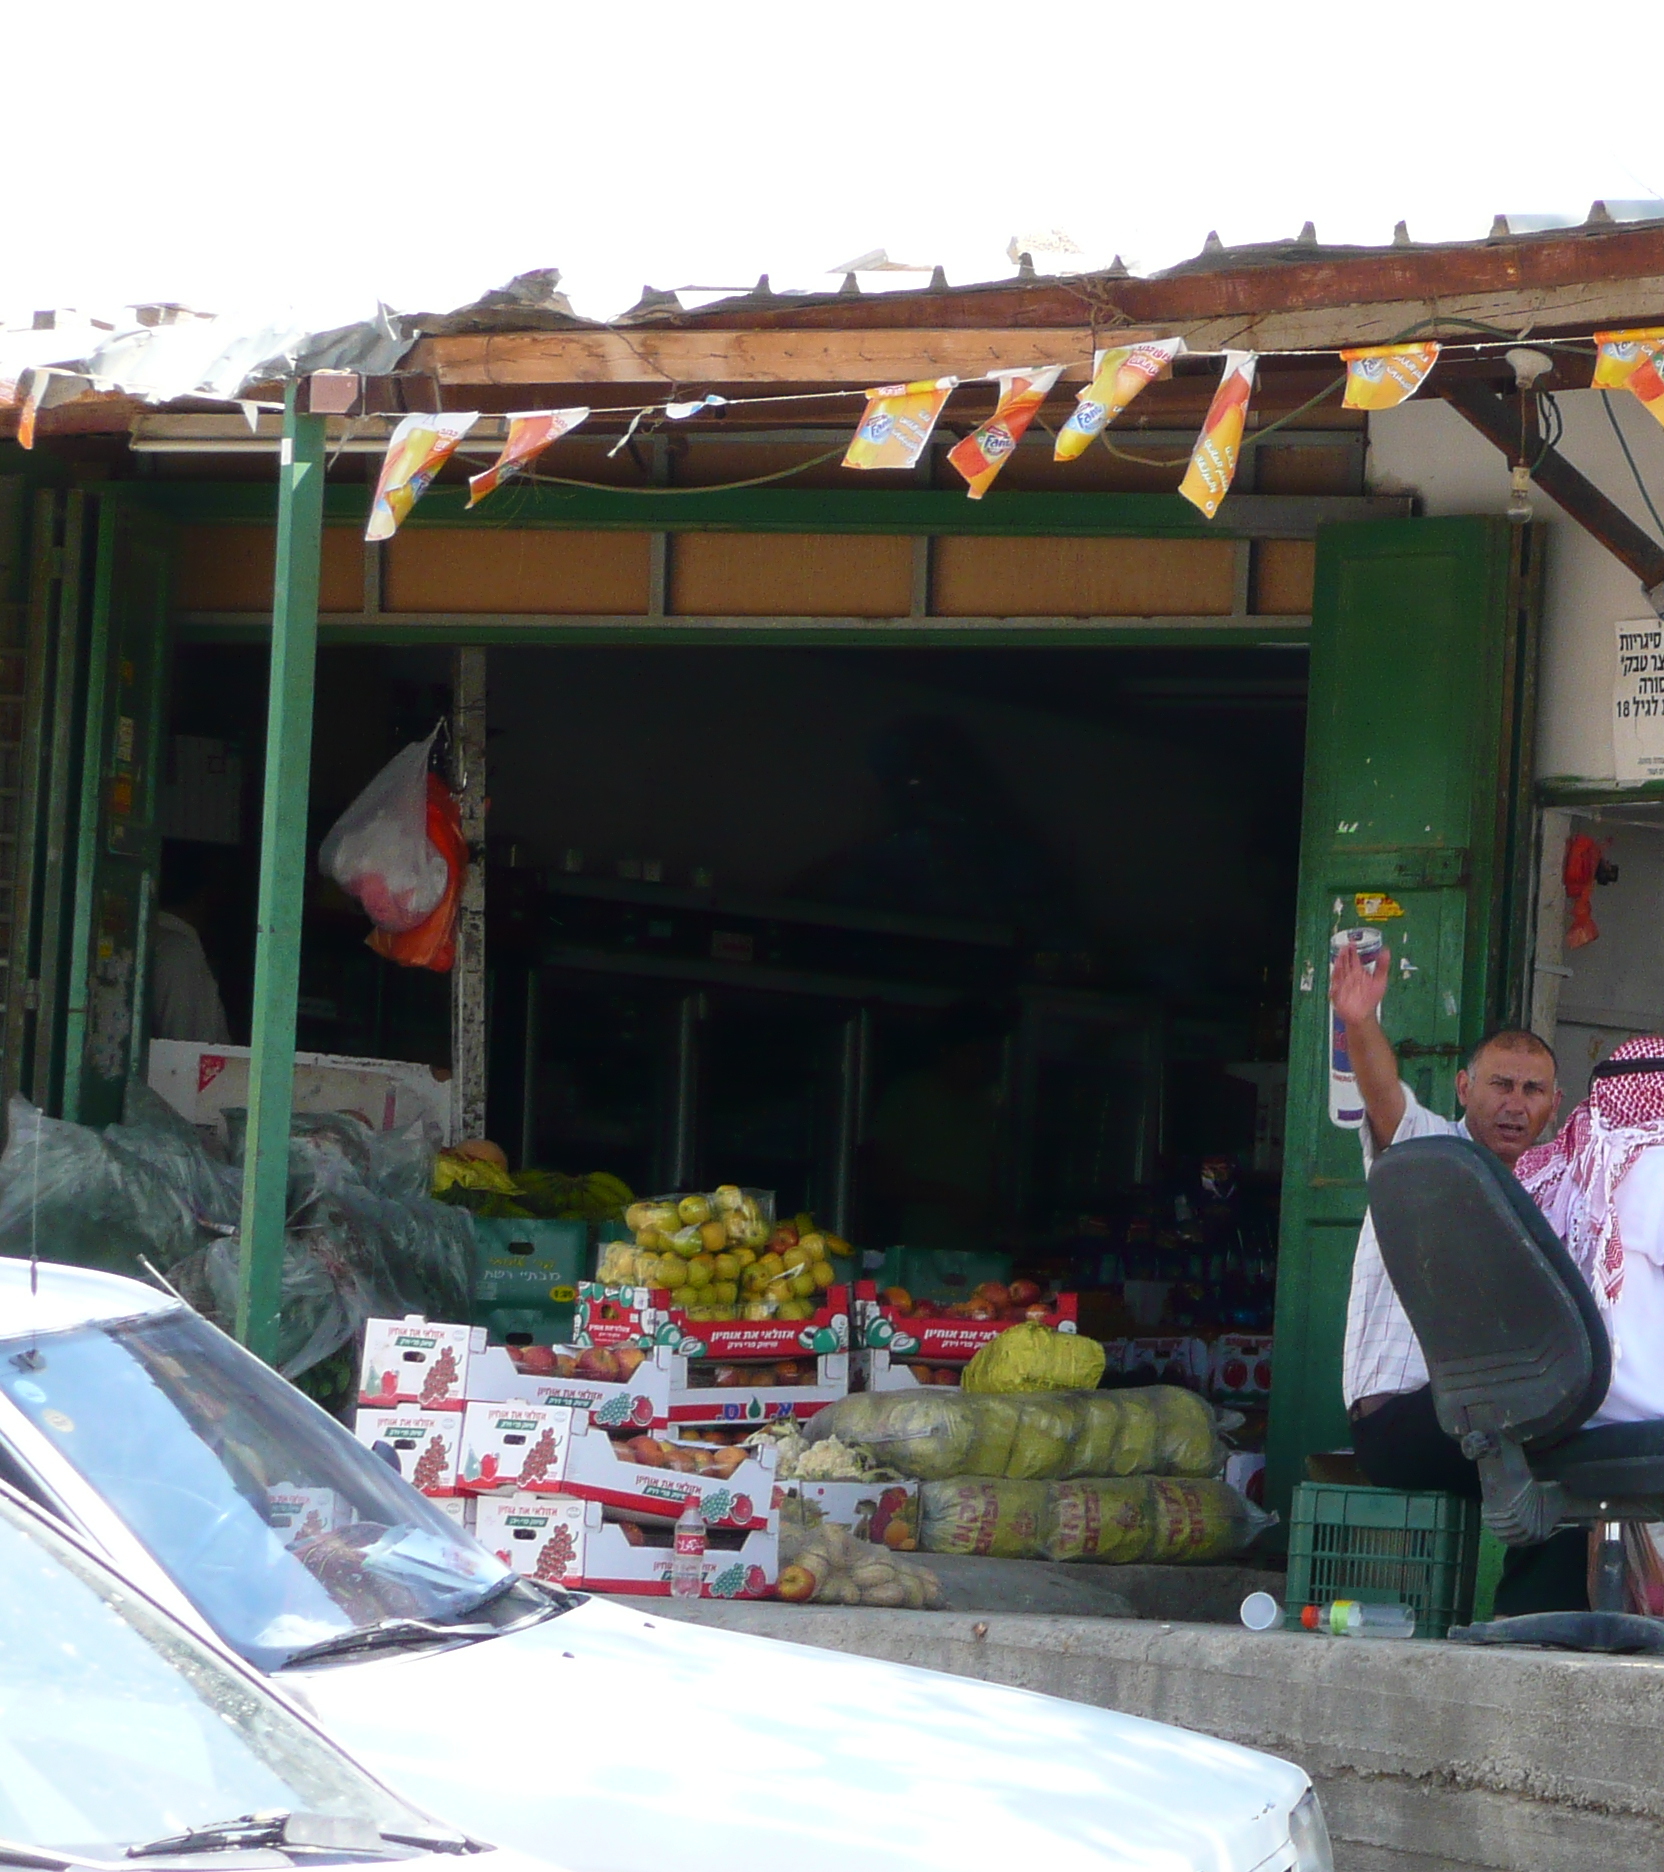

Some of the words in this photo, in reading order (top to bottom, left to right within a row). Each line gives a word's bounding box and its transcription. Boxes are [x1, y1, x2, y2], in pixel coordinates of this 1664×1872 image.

[1619, 632, 1662, 651] סיגריות
[1617, 700, 1630, 718] 18
[1632, 696, 1659, 717] לגיל
